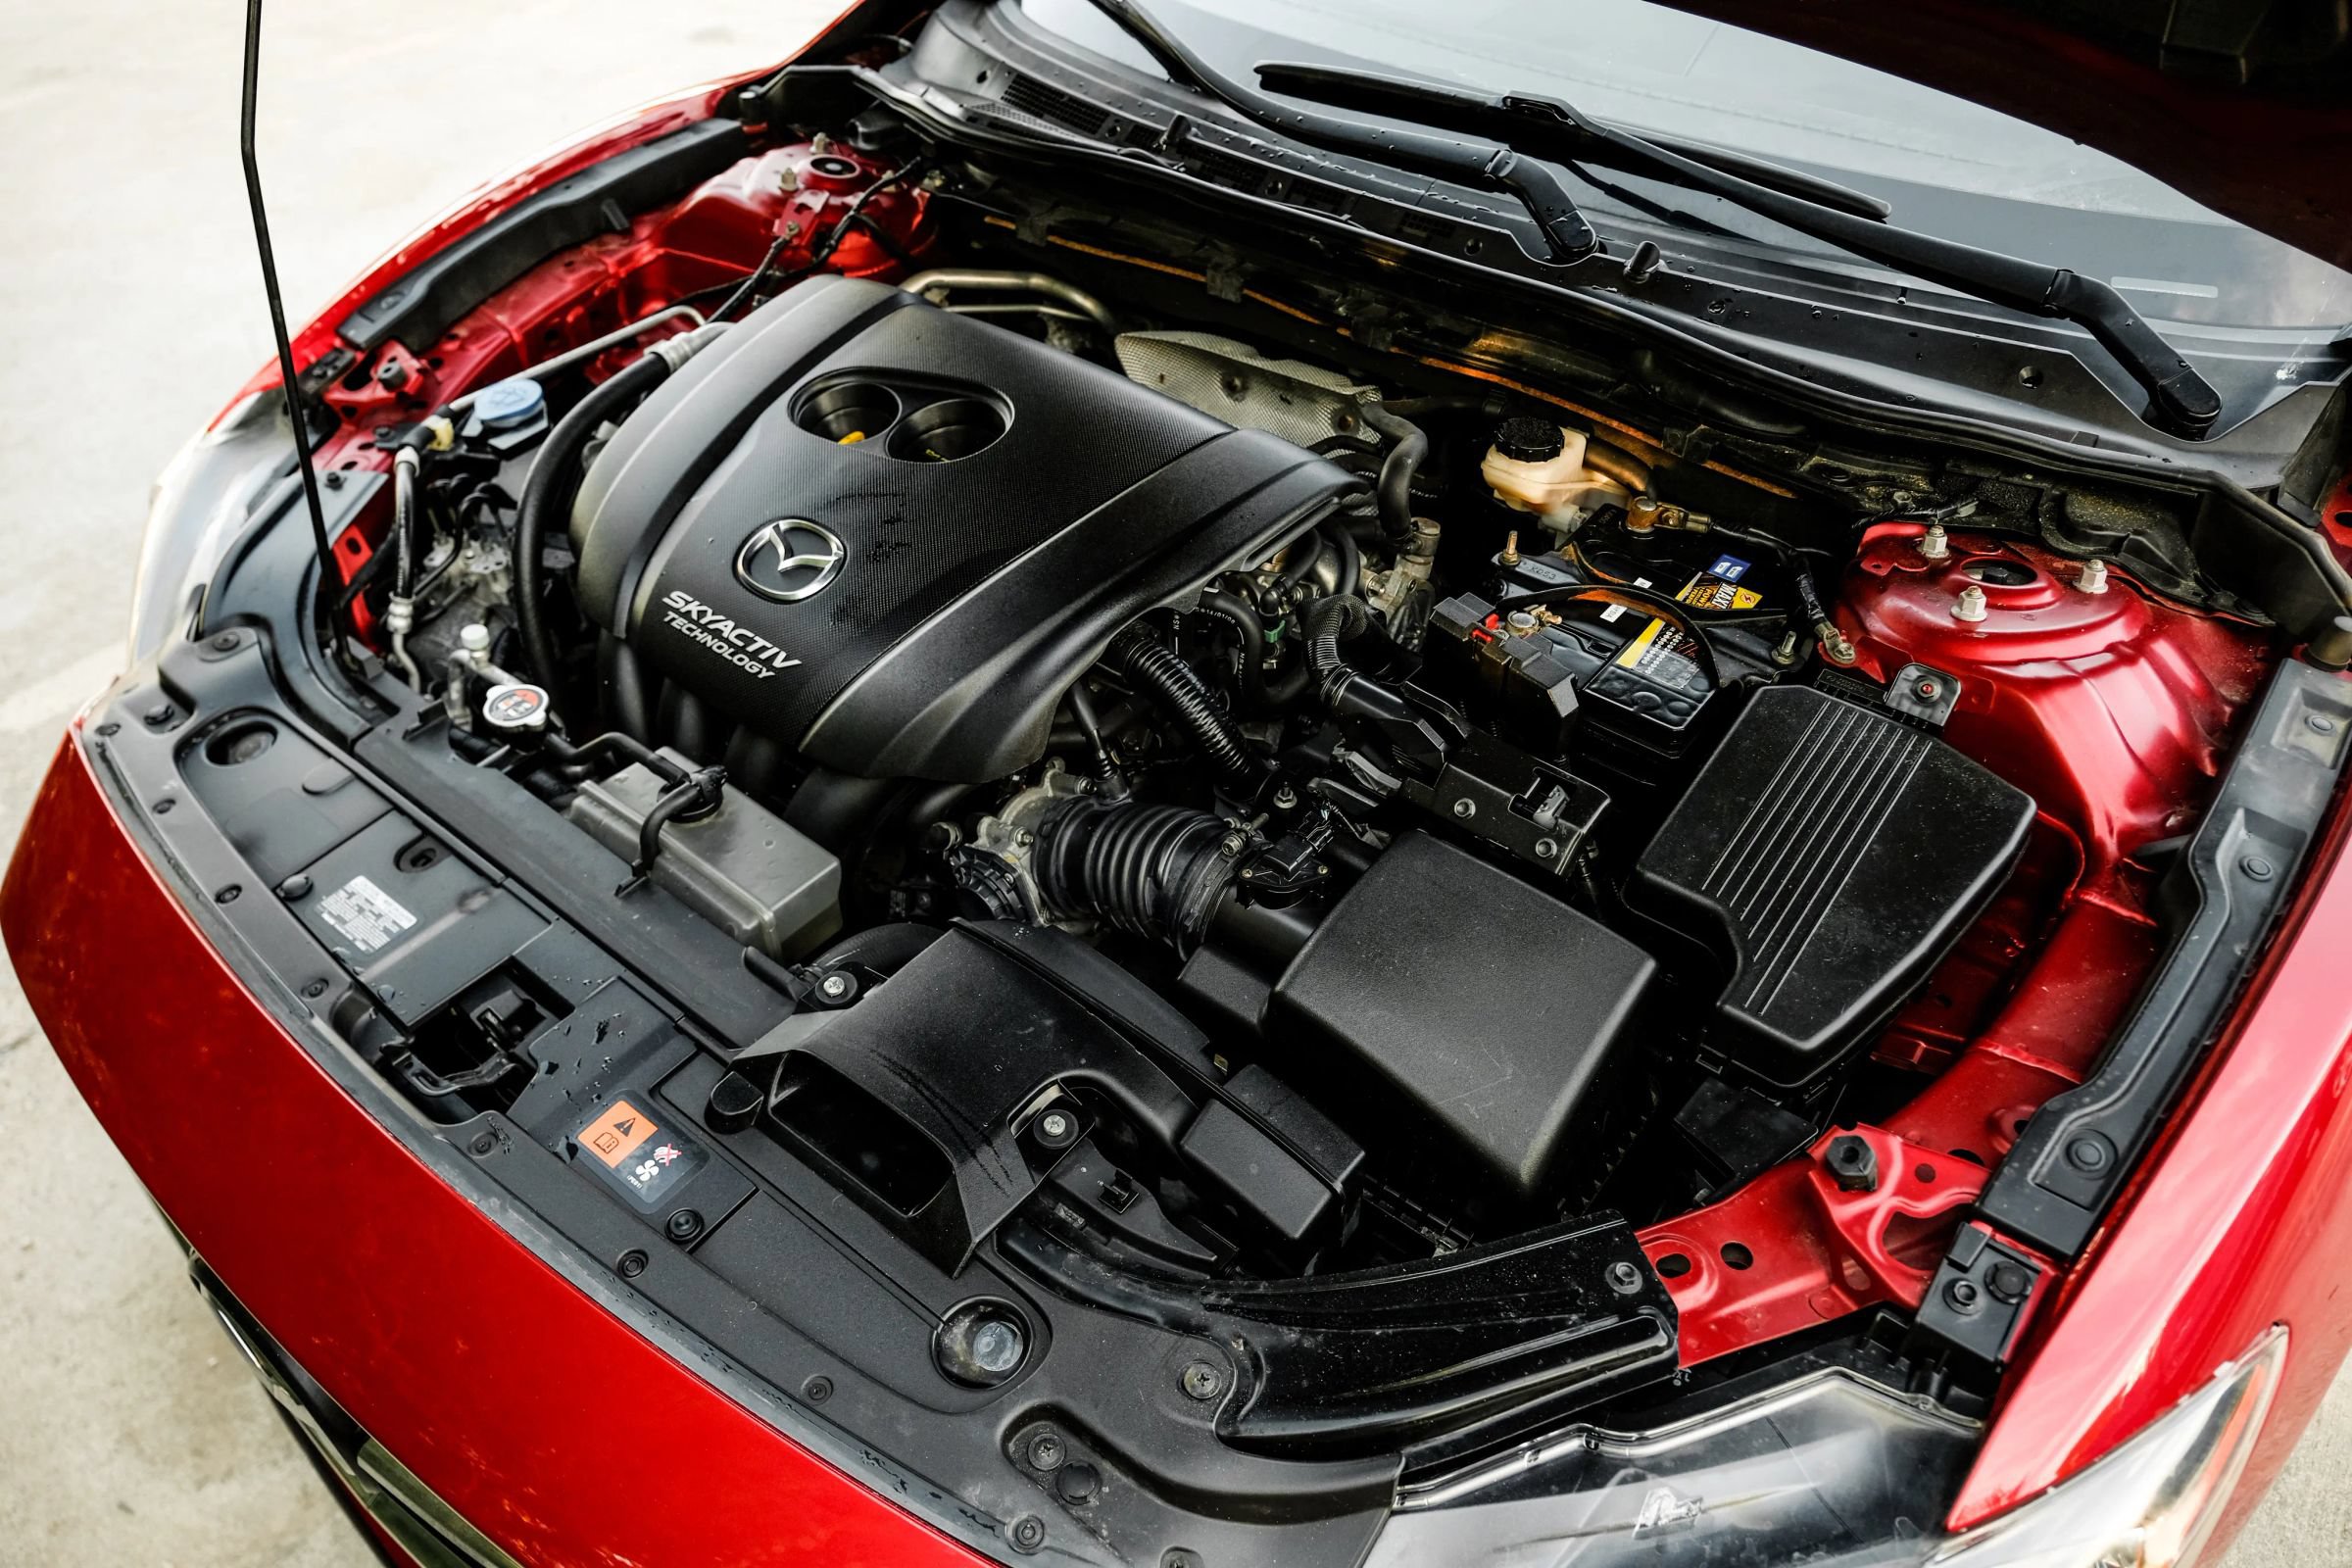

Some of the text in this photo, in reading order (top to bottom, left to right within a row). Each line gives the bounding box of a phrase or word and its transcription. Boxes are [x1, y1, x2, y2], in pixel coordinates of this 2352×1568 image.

[662, 590, 803, 669] SKYACTIV
[1712, 583, 1738, 610] MAXI
[662, 611, 776, 679] TECHNOLOGY
